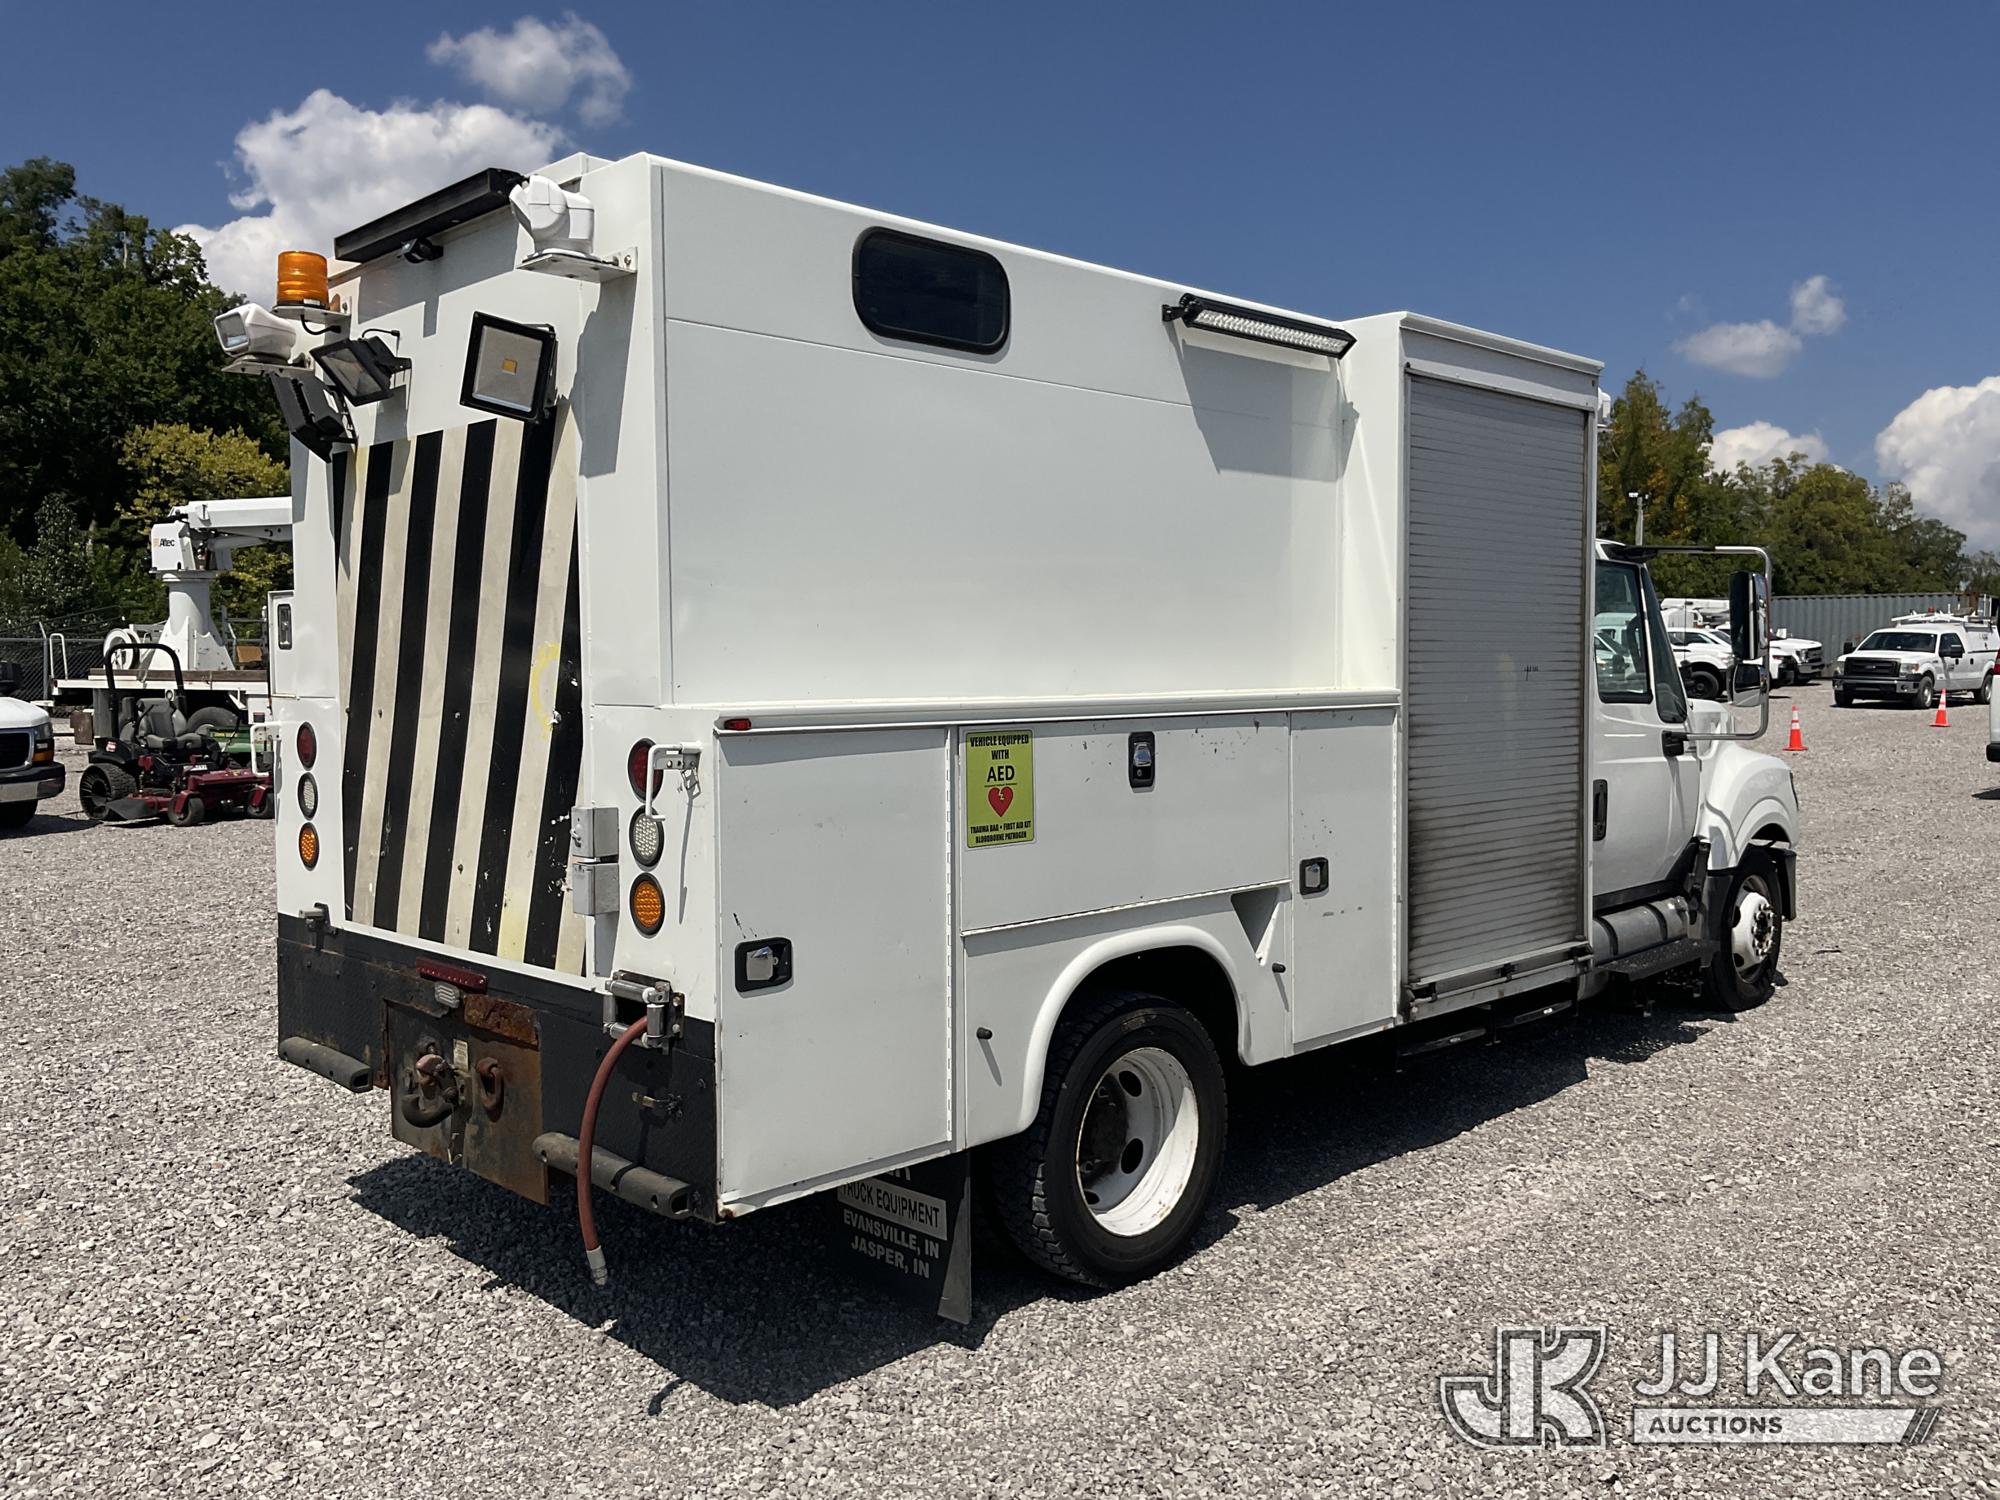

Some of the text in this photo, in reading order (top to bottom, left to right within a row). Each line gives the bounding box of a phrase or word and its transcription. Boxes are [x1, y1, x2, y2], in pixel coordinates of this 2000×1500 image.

[970, 734, 1029, 747] VEHICLE EQUIPPED
[991, 749, 1009, 760] WITH
[987, 765, 1015, 782] AED
[1003, 822, 1015, 831] FIRST
[1015, 821, 1024, 829] AID
[876, 1188, 940, 1228] EQUIPMENT
[843, 1209, 939, 1259] EVANSVILLE, IN
[851, 1235, 930, 1279] JASPER, IN
